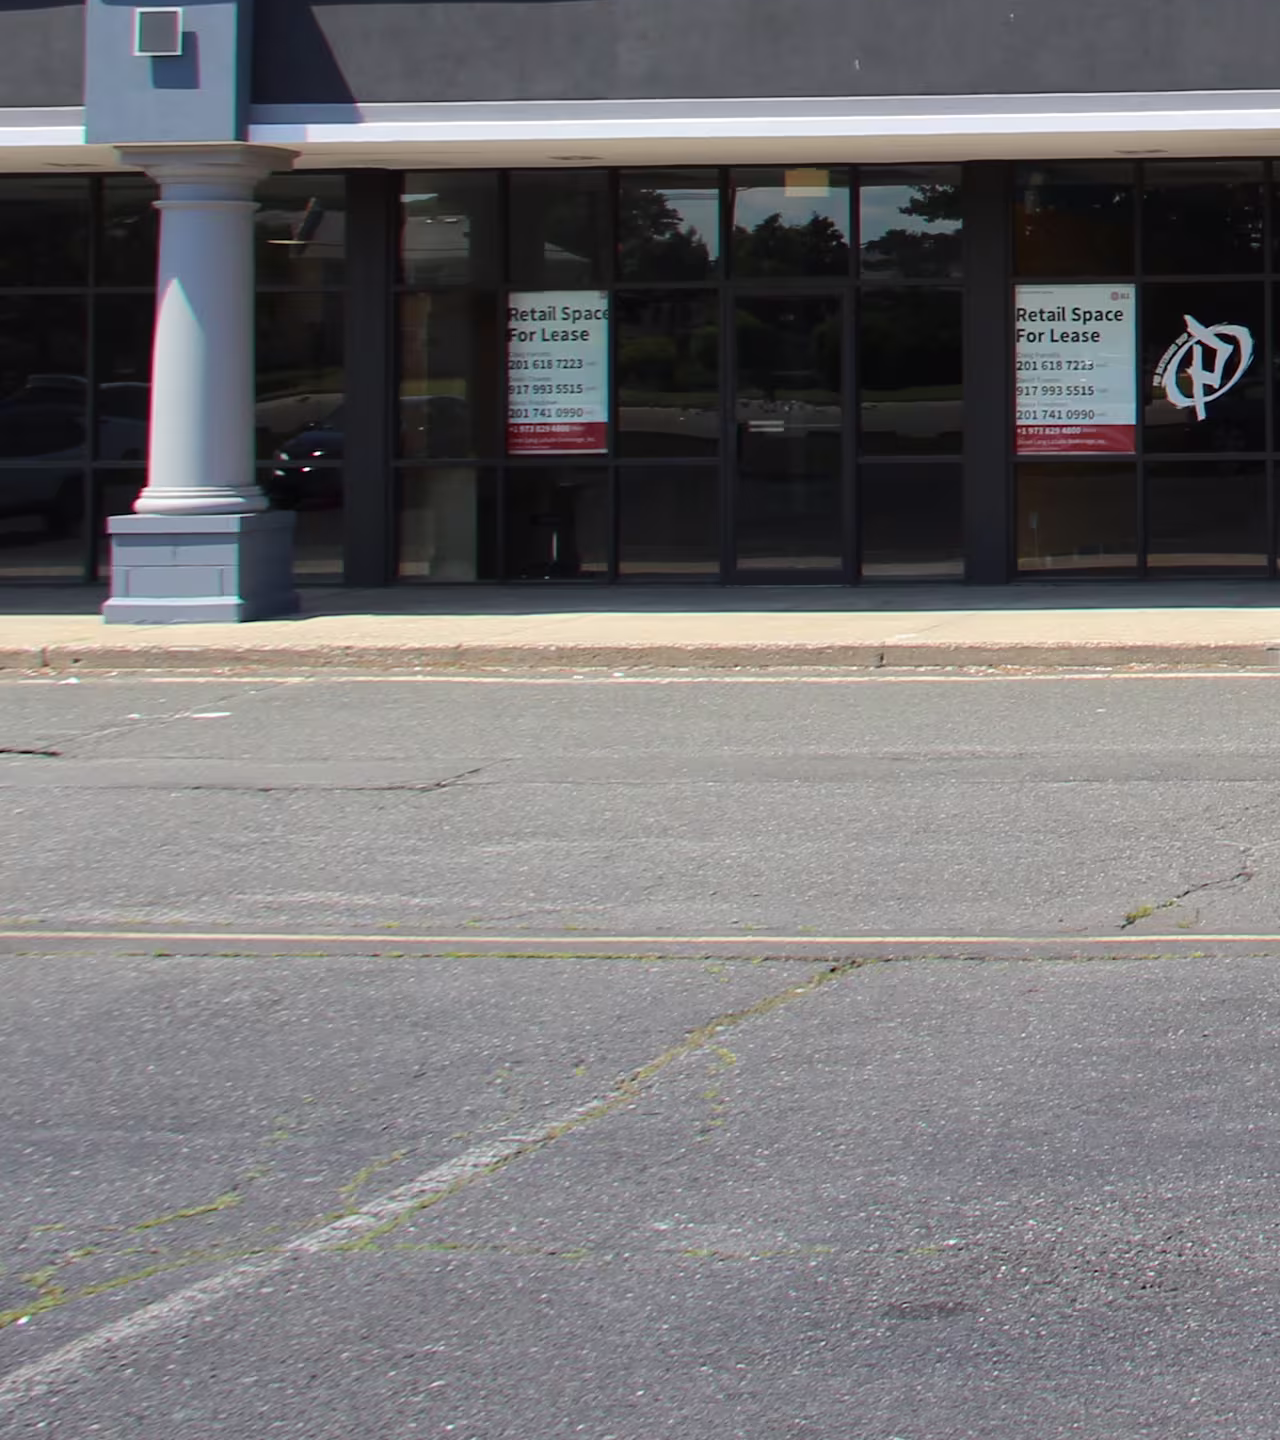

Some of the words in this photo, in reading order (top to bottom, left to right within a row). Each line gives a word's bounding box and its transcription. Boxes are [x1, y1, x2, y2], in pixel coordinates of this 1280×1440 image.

[508, 306, 556, 321] Retail
[1016, 306, 1065, 322] Retail
[1072, 307, 1124, 324] Space
[508, 329, 536, 342] For
[542, 328, 590, 342] Lease
[1016, 329, 1044, 343] For
[1050, 328, 1100, 342] Lease
[508, 359, 529, 370] 201
[533, 359, 553, 370] 618
[556, 359, 583, 369] 7223
[1016, 361, 1037, 371] 201
[1041, 360, 1063, 371] 618
[1067, 360, 1094, 371] 7223
[532, 384, 553, 395] 993
[556, 383, 584, 394] 5515
[1016, 386, 1038, 396] 917
[1042, 386, 1063, 396] 993
[1066, 385, 1095, 396] 5515
[533, 408, 553, 418] 741
[1016, 410, 1038, 420] 201
[1042, 410, 1062, 420] 741
[1066, 409, 1095, 420] 0990
